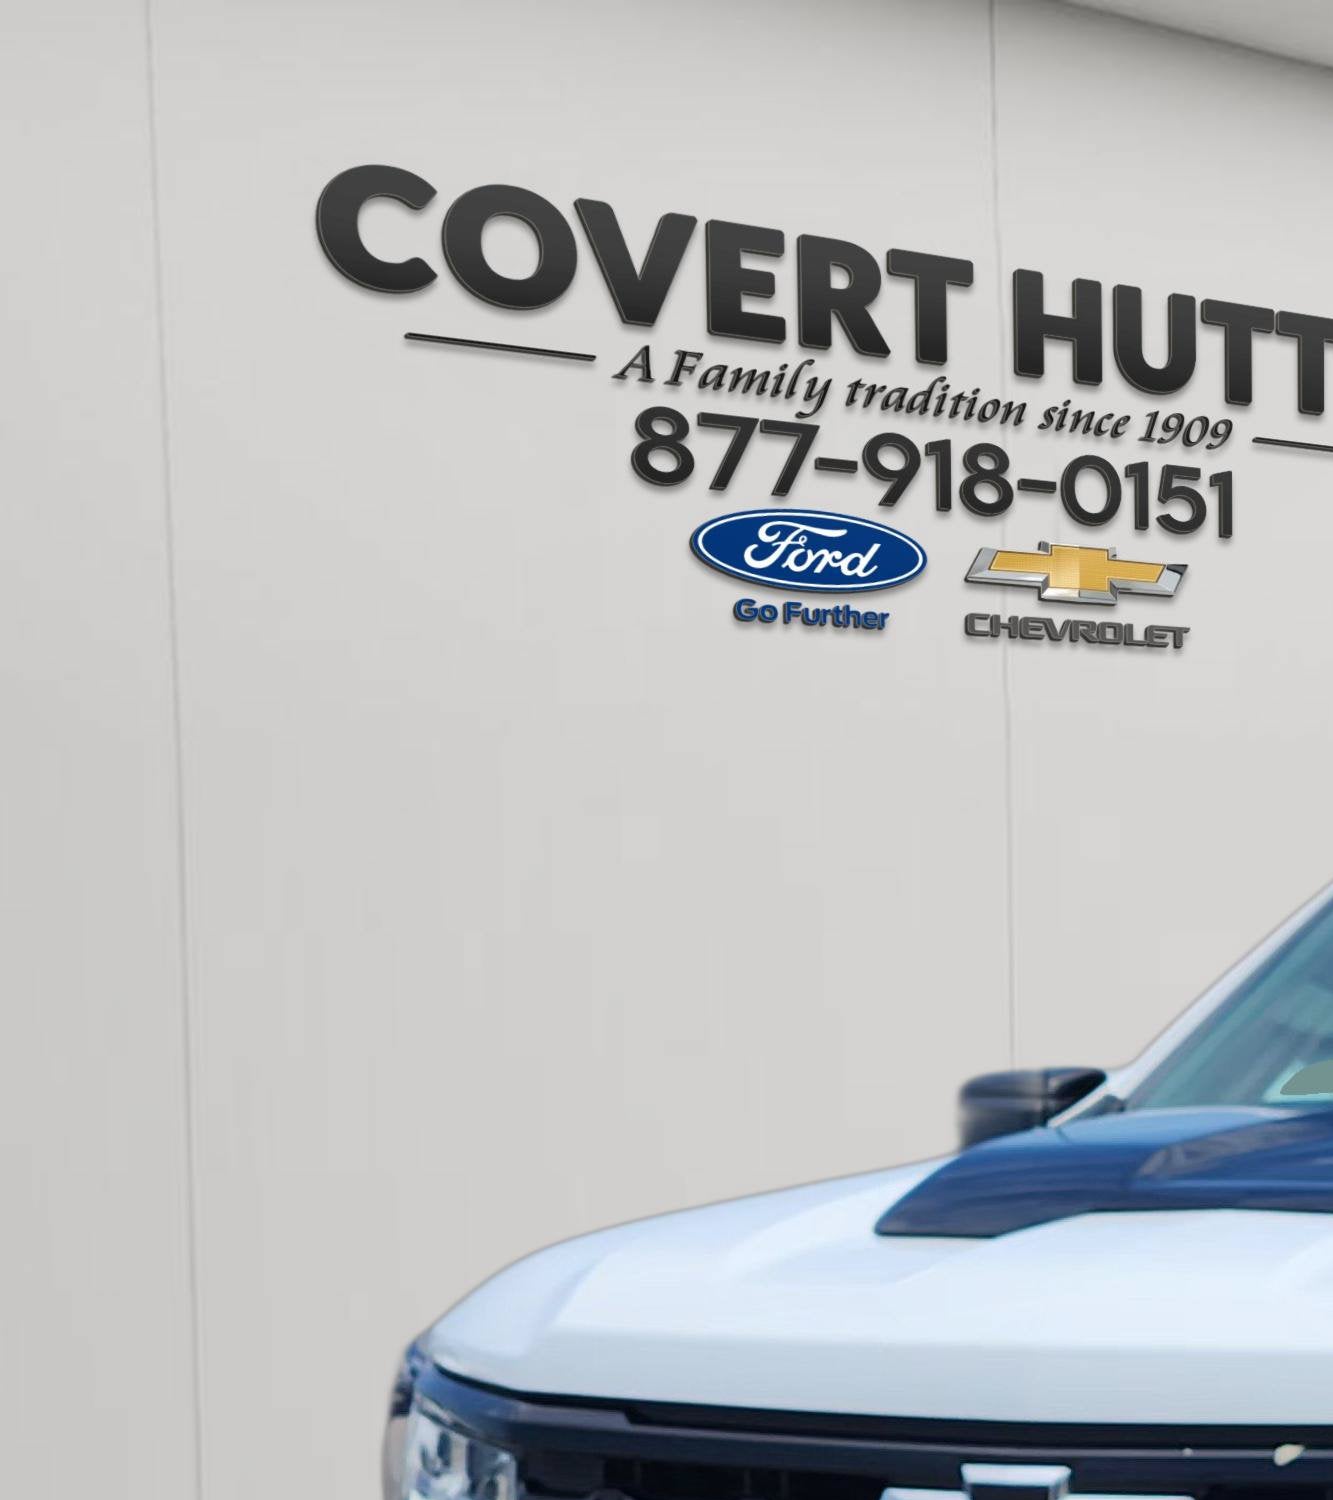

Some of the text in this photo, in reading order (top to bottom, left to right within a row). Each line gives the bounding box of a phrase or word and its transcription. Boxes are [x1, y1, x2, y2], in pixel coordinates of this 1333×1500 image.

[315, 164, 974, 368] COVERT
[611, 344, 1235, 452] A Family tradition since 1909
[630, 406, 1234, 541] 877-918-0151
[743, 519, 880, 579] Ford
[733, 598, 890, 632] Go Further
[963, 611, 1191, 651] CHEVROLET
